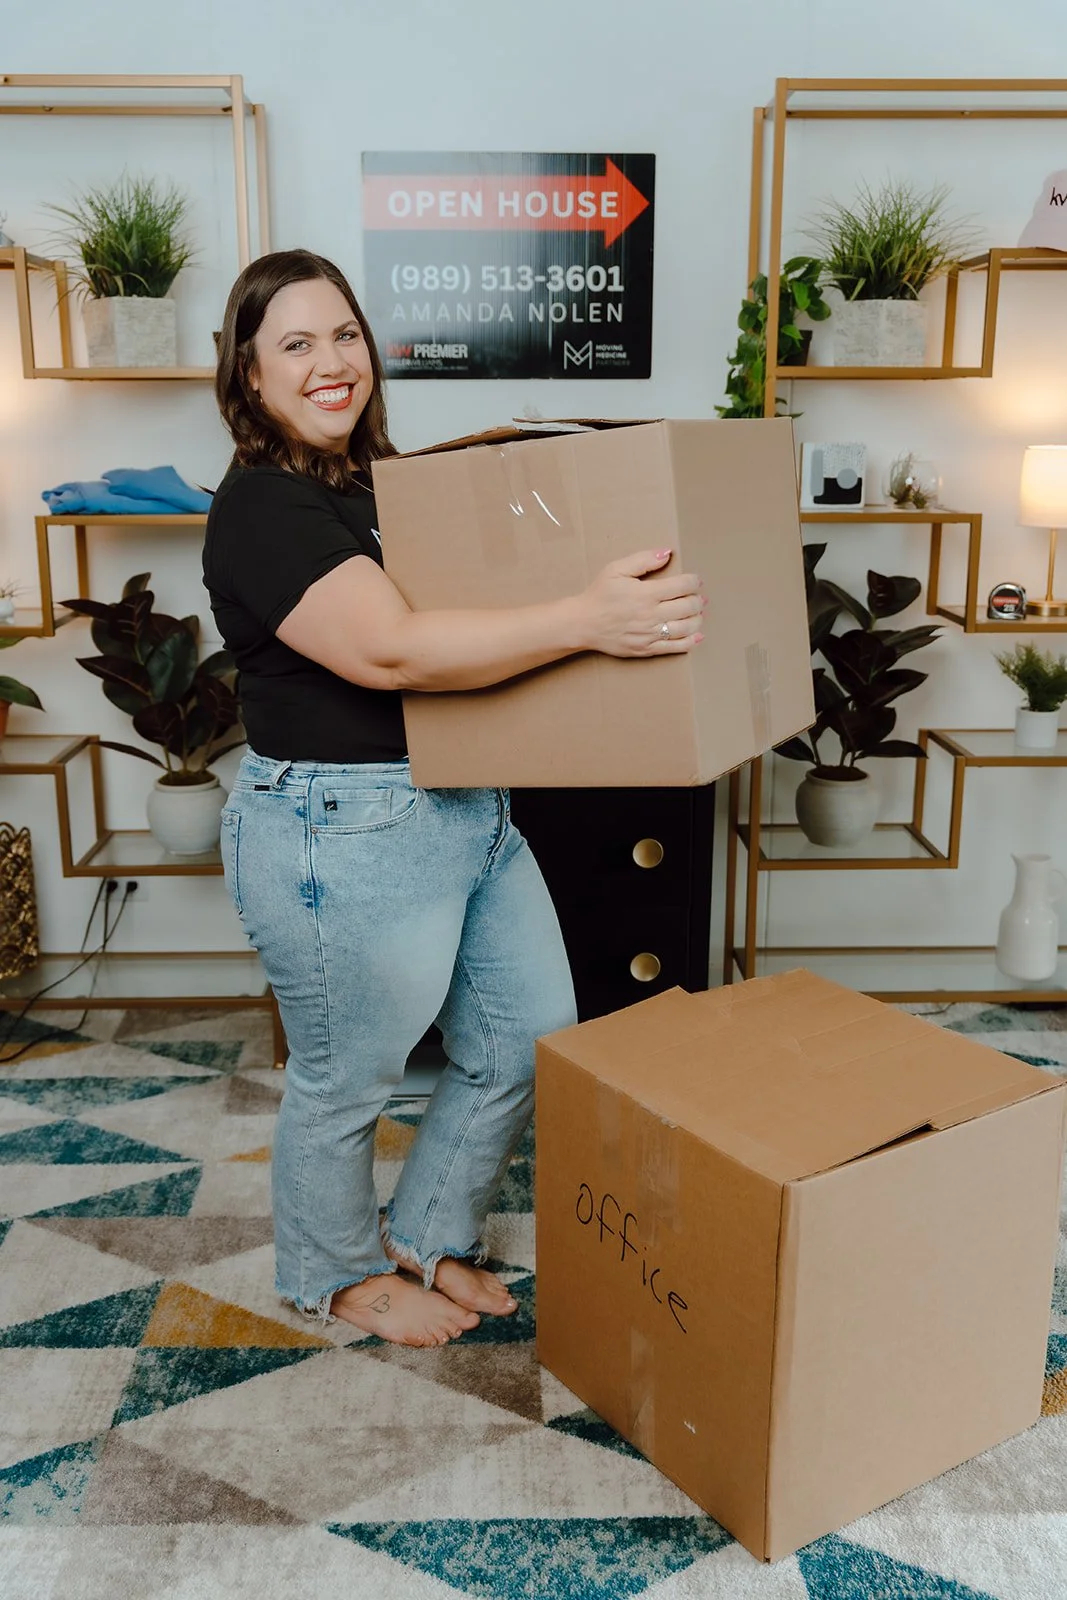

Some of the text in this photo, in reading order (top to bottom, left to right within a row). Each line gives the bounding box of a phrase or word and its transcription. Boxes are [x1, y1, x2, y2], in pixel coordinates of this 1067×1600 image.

[387, 190, 619, 218] OPEN HOUSE
[390, 264, 625, 294] (989) 513-3601
[391, 302, 623, 323] AMANDA NOLEN
[414, 343, 468, 359] PREMIER
